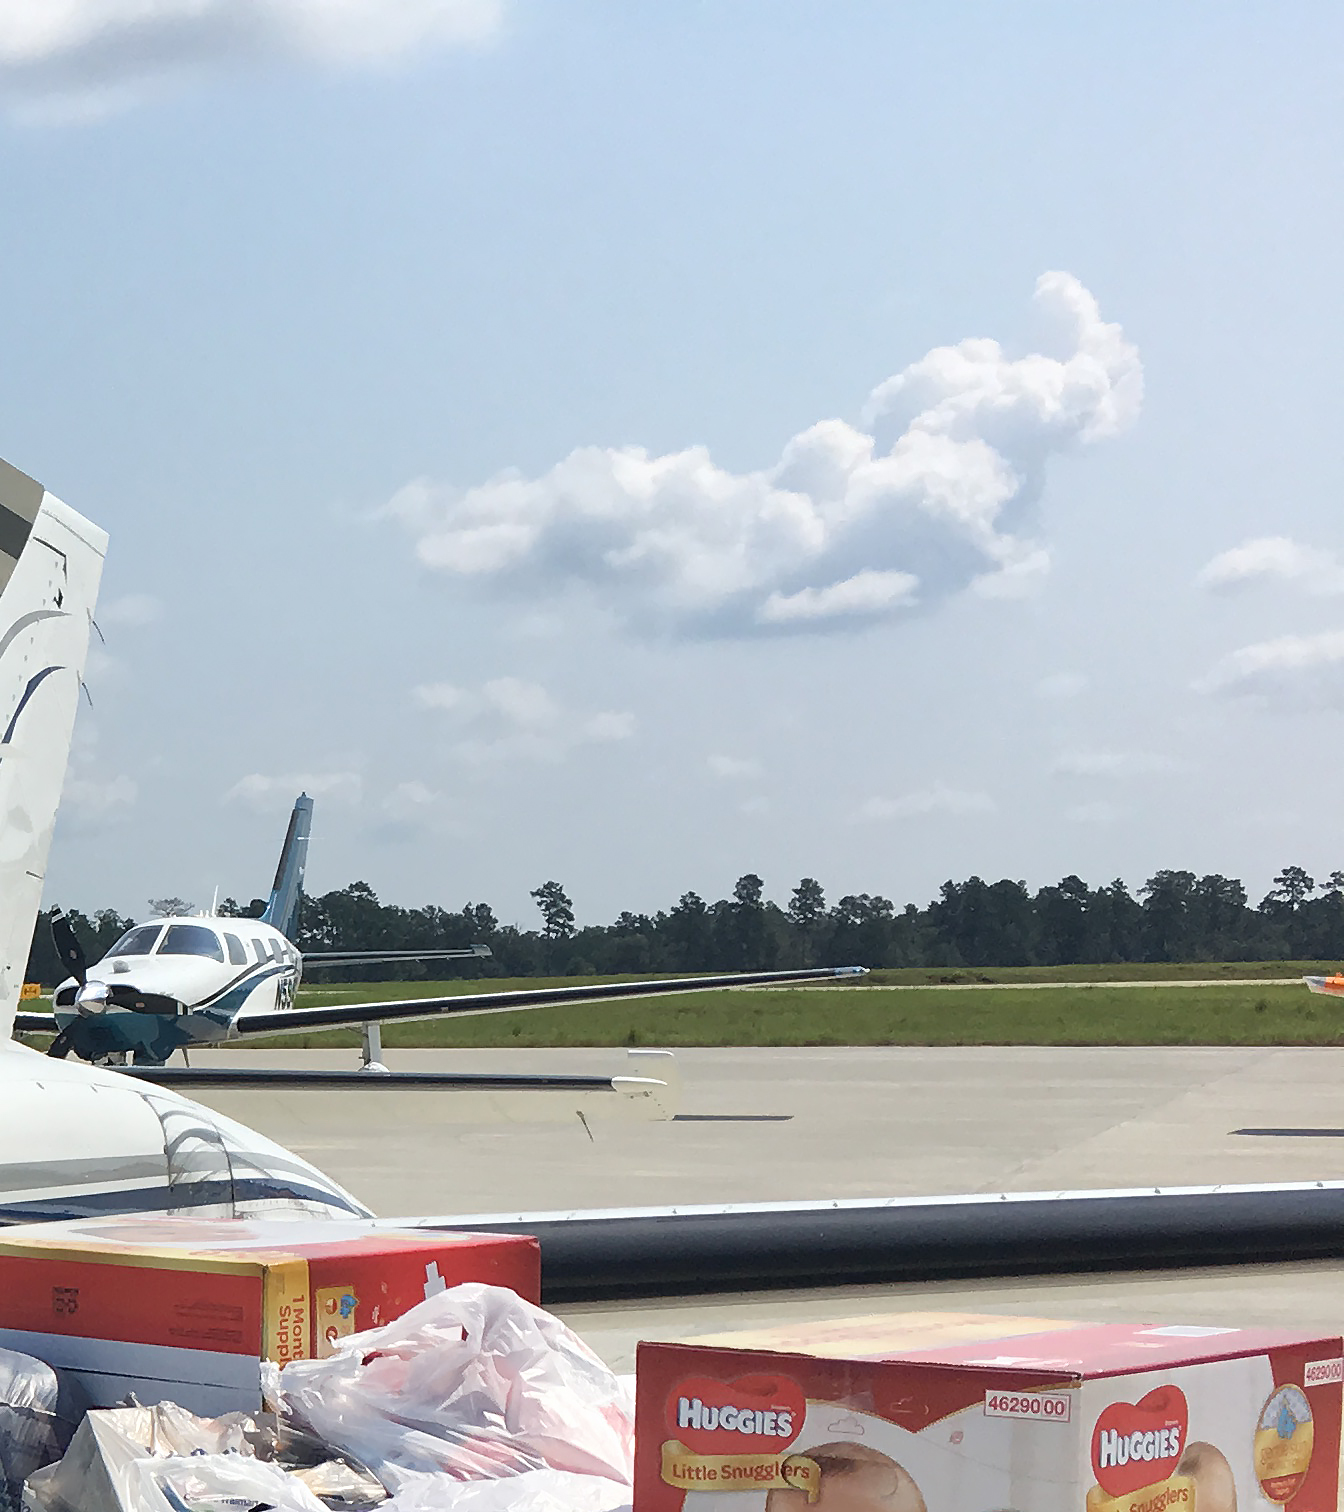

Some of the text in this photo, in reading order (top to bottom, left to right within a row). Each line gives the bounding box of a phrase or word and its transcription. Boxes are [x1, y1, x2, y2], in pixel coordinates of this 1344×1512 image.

[276, 1305, 292, 1368] Suppl
[291, 1294, 305, 1362] 1 Mont
[677, 1396, 794, 1438] HUGGIES
[988, 1394, 1065, 1416] 46290 00
[1099, 1427, 1180, 1468] HUGGIES
[672, 1461, 810, 1482] Little Snugglers
